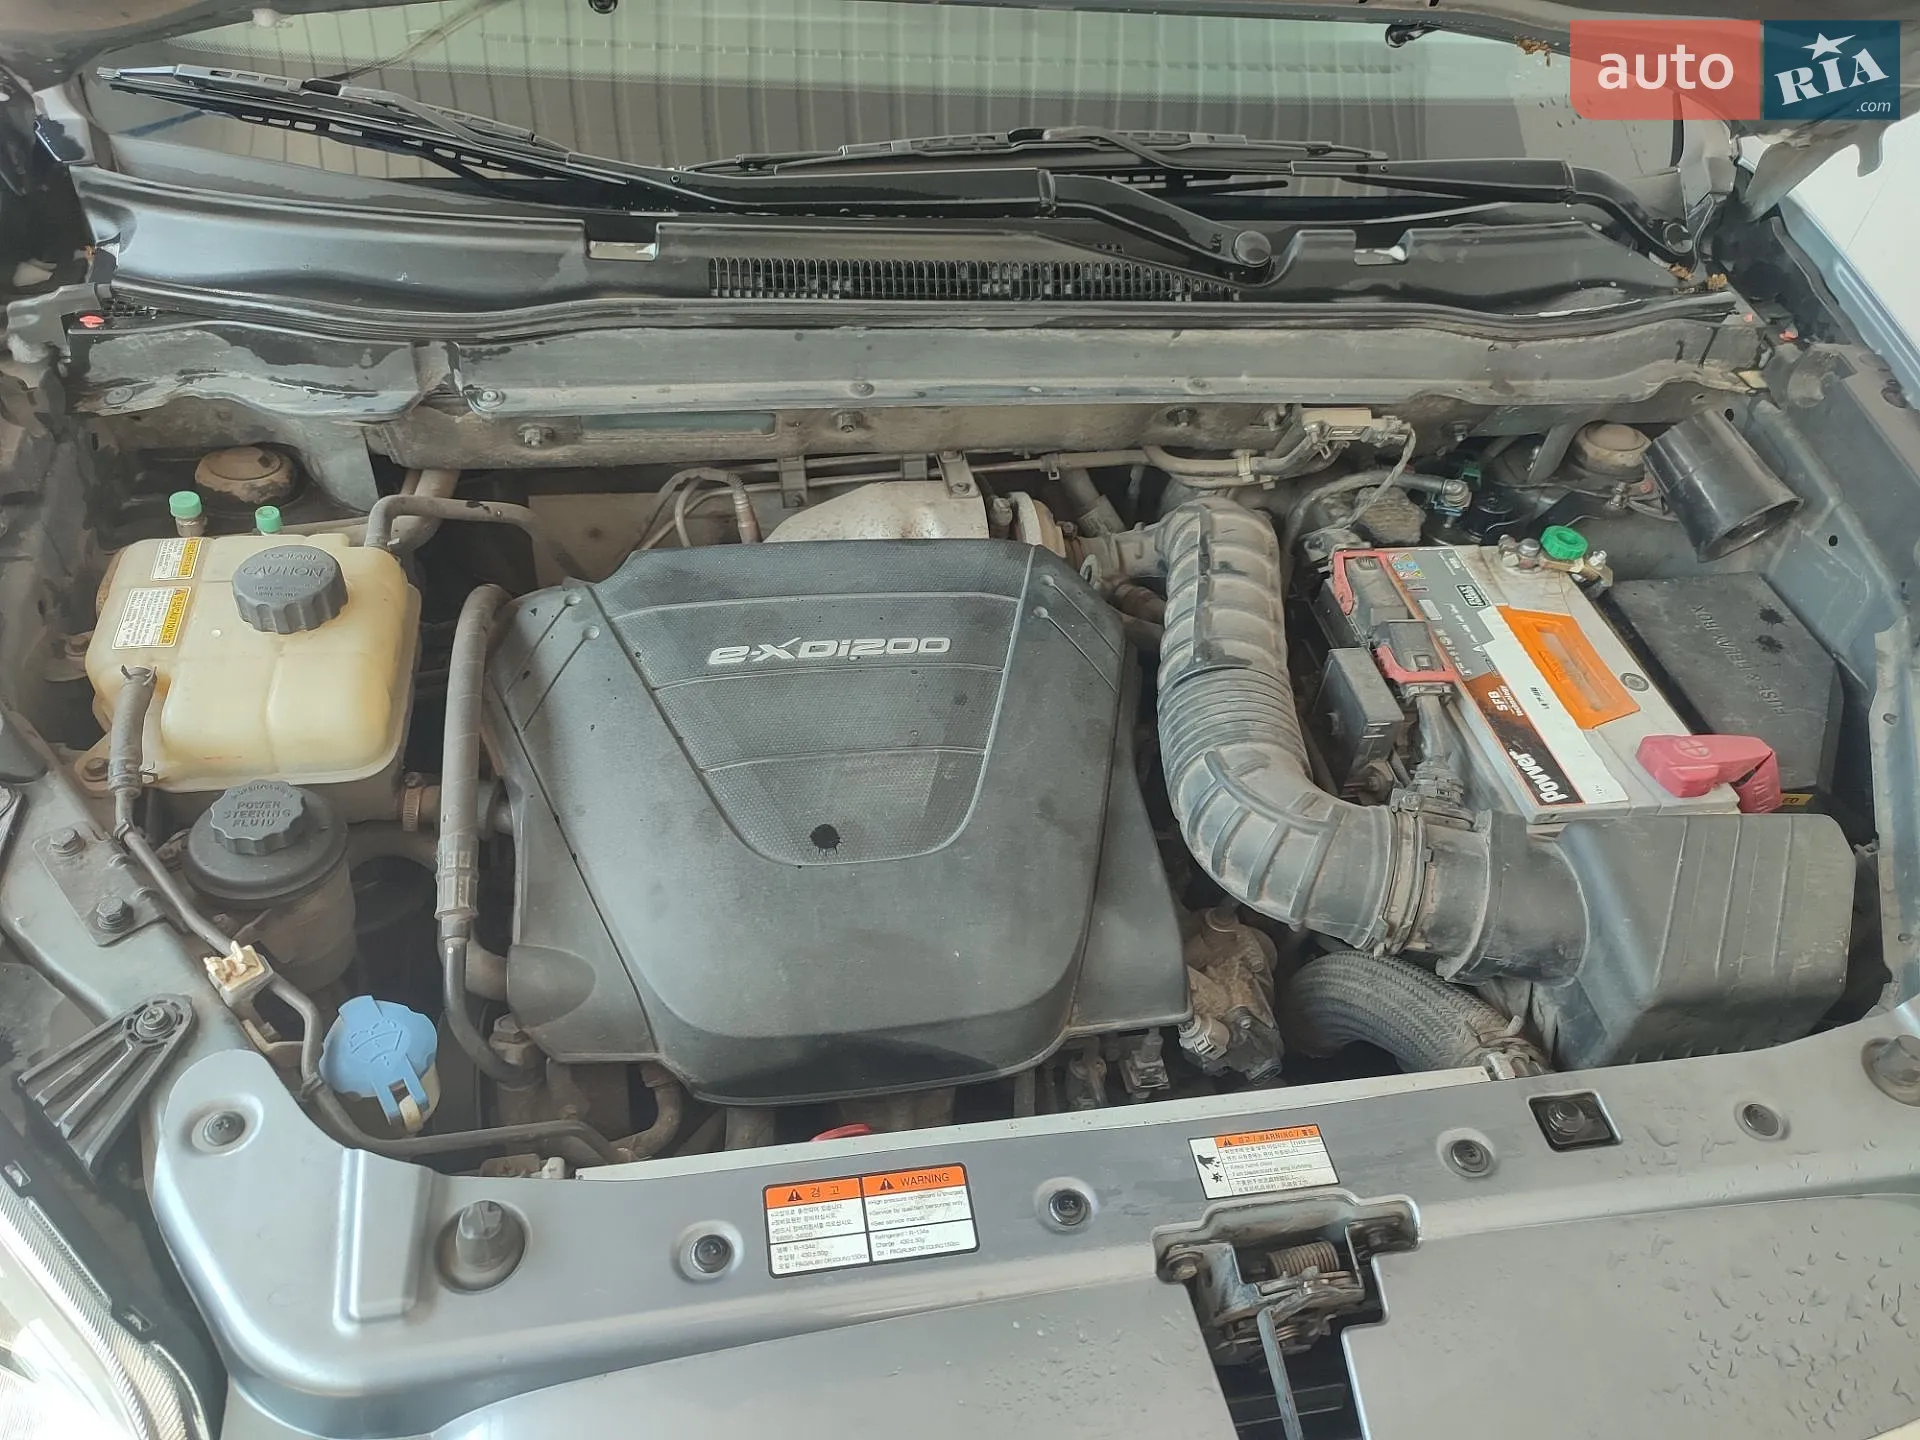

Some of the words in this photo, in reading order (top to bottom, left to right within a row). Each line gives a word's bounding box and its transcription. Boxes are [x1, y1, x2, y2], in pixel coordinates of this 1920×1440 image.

[243, 565, 326, 577] CAUTION
[1487, 690, 1508, 711] SFB
[1508, 748, 1569, 803] Power
[237, 801, 281, 810] POWER
[224, 809, 291, 820] STEERING
[232, 819, 276, 828] FLUID
[1258, 1131, 1294, 1140] WARNING
[900, 1172, 950, 1187] WARNING
